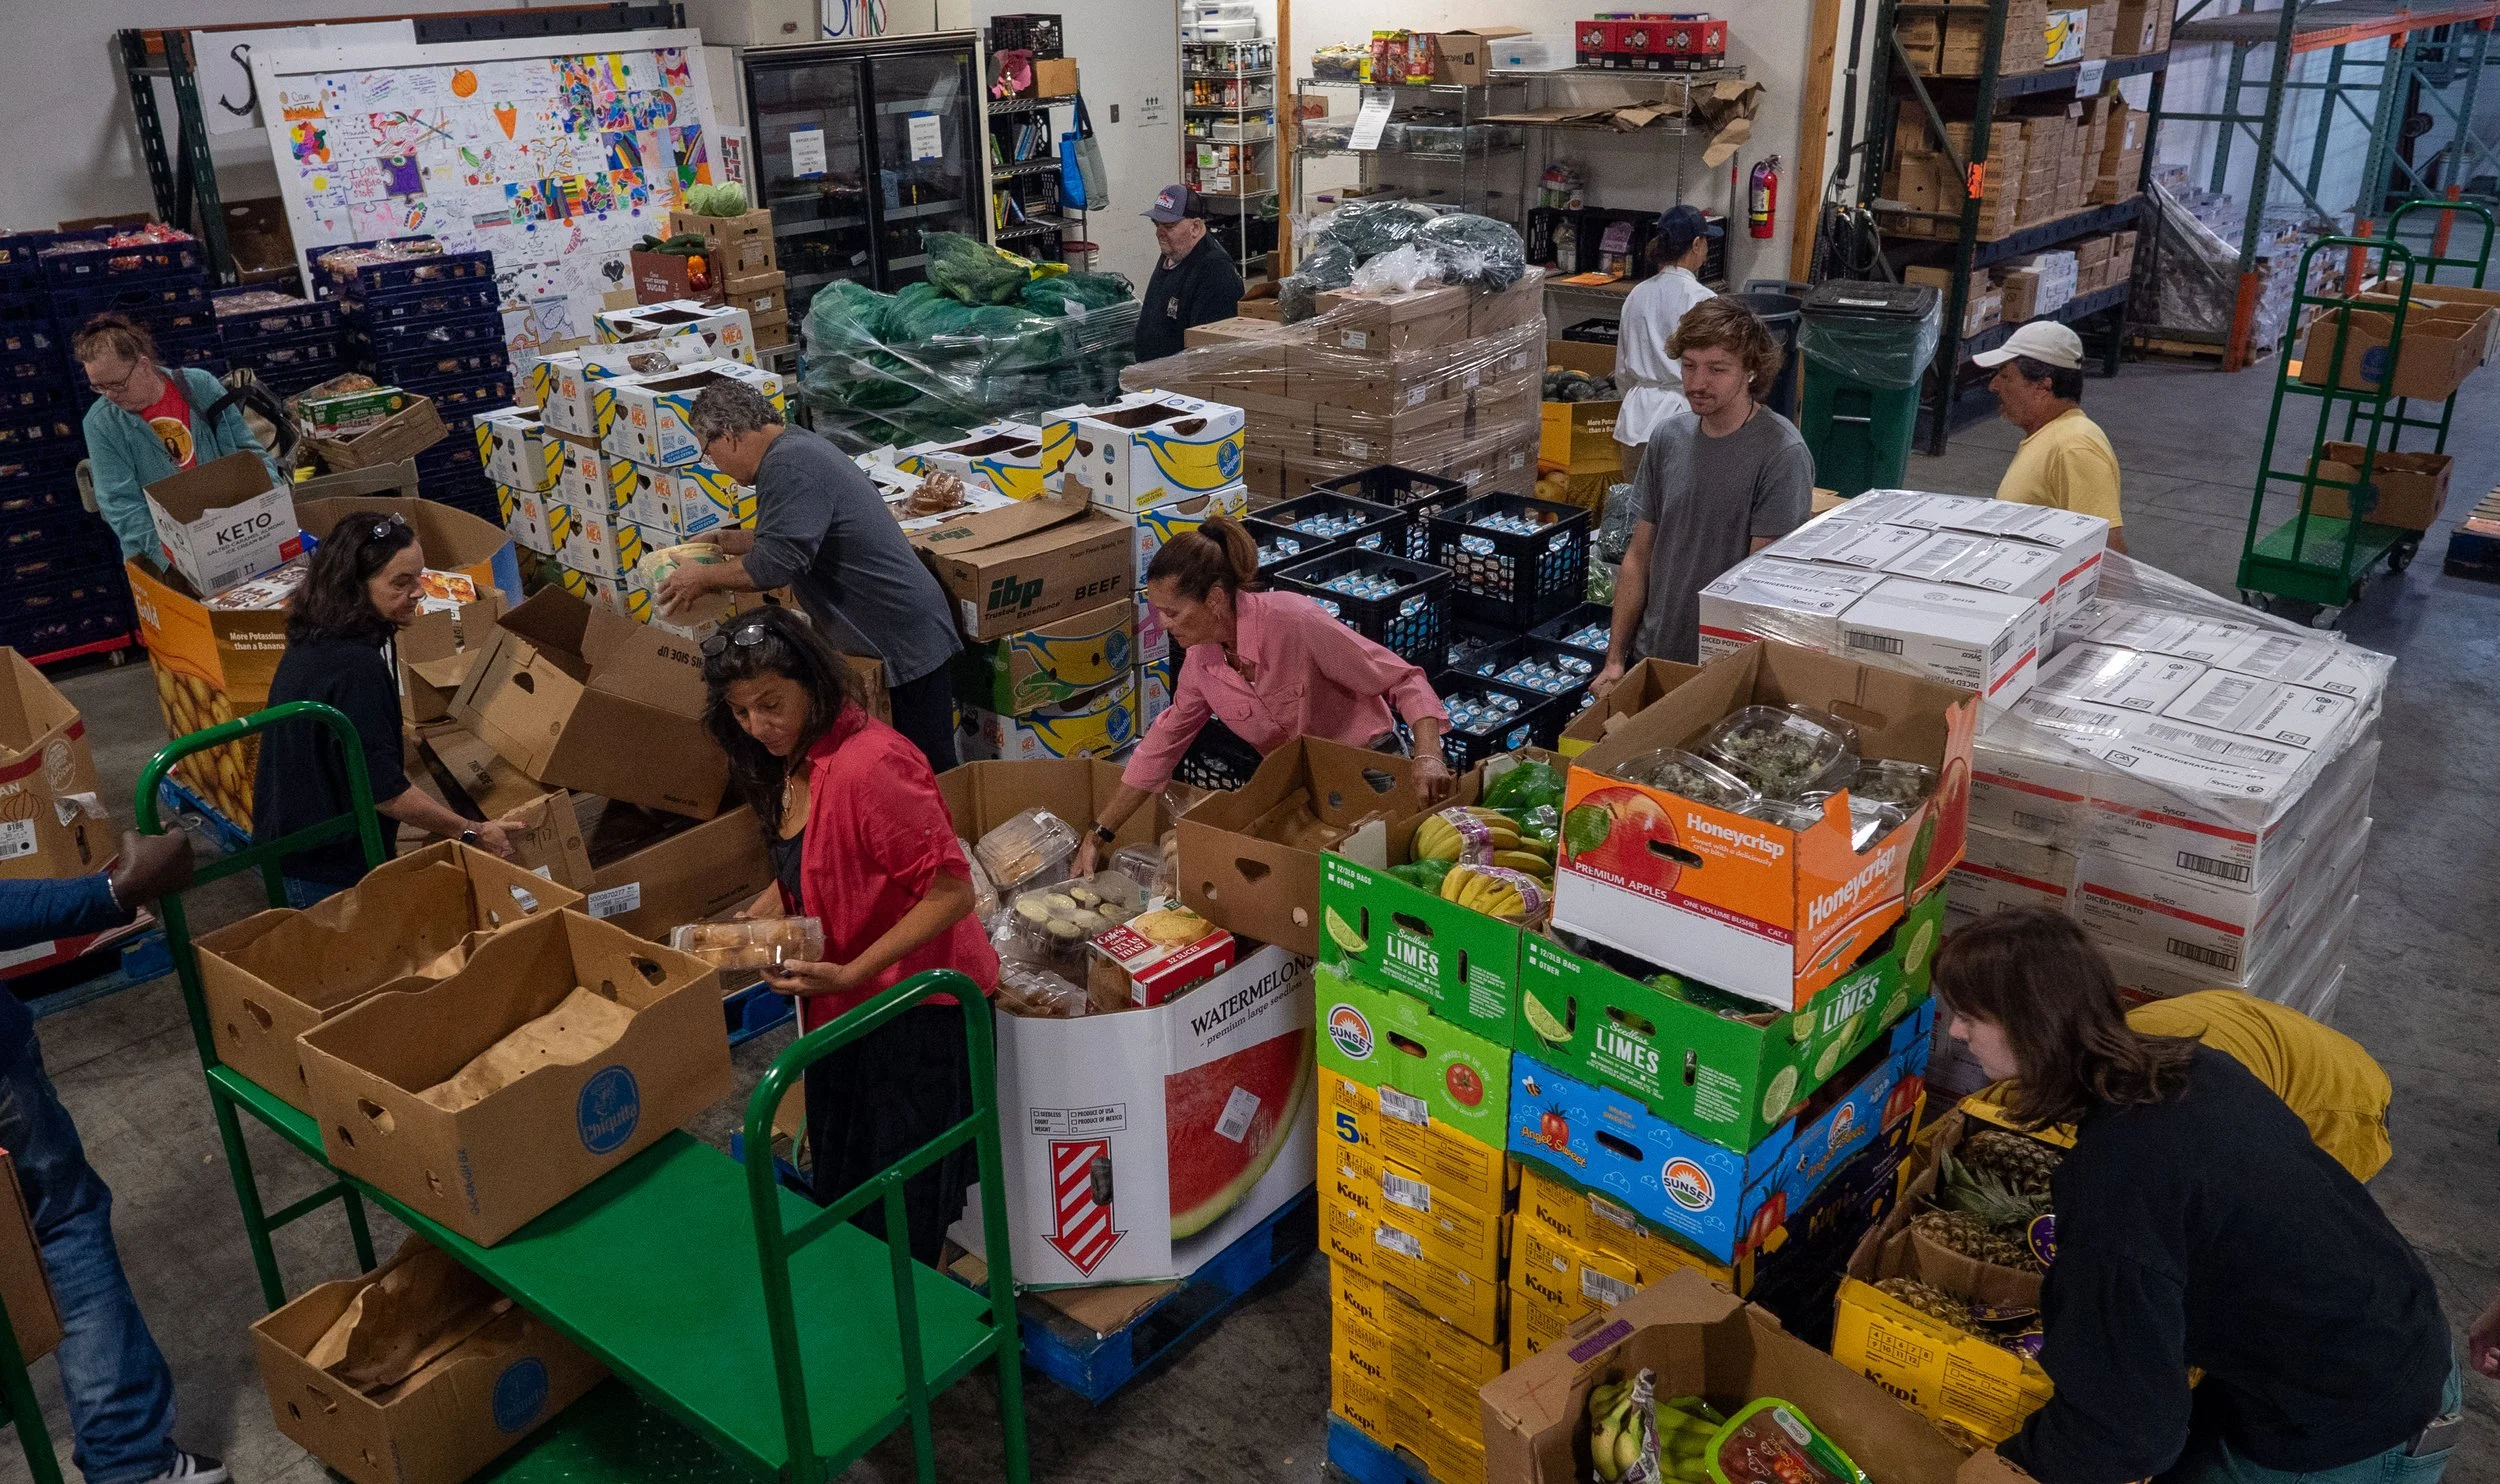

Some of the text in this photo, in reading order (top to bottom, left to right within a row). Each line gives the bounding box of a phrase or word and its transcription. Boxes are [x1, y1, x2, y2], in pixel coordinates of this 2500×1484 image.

[216, 513, 272, 546] KETO
[986, 575, 1044, 612] ibp
[1075, 574, 1121, 600] BEEF
[984, 601, 1061, 621] Trusted Excellence
[229, 632, 286, 641] More Potassium
[234, 642, 251, 650] than
[258, 642, 286, 650] Banana
[1701, 636, 1721, 646] DICED
[657, 645, 690, 665] SIDE UP
[1958, 679, 1980, 689] DICED
[2210, 779, 2240, 790] Sysco
[2162, 805, 2187, 818] Sysco
[1686, 812, 1785, 859] Honeycrisp
[1711, 841, 1728, 852] with
[1735, 850, 1774, 867] deliciously
[1575, 862, 1626, 886] PREMIUM
[1628, 880, 1668, 900] APPLES
[1807, 845, 1897, 931] Honeycrisp
[2085, 893, 2145, 916] DICED POTATO
[2152, 893, 2176, 906] Sysco
[1683, 899, 1699, 910] ONE
[1700, 905, 1731, 920] VOLUME
[1731, 915, 1760, 930] BUSHEL
[1096, 926, 1128, 947] Cole's
[1109, 935, 1142, 954] TEXAS
[1118, 940, 1149, 960] TOAST
[1396, 928, 1430, 950] Seedless
[1166, 944, 1201, 965] 32 SLICES
[1387, 934, 1439, 977] LIMES
[1822, 976, 1880, 1034] LIMES
[1206, 1016, 1246, 1048] premium
[1247, 1002, 1269, 1021] large
[1329, 1025, 1374, 1054] SUNSET
[1609, 1021, 1650, 1046] Seedless
[1596, 1027, 1660, 1075] LIMES
[583, 1102, 638, 1144] Chiquita
[1335, 1111, 1360, 1144] 5
[1520, 1125, 1587, 1169] Angel Sweet
[1336, 1180, 1370, 1210] Kapi
[1663, 1174, 1714, 1206] SUNSET
[1536, 1203, 1574, 1239] Kapi
[1330, 1237, 1365, 1266] Kapi
[1525, 1272, 1565, 1306] Kapi
[1343, 1288, 1374, 1321] Kapi
[1349, 1349, 1382, 1382] Kapi
[1343, 1402, 1377, 1434] Kapi
